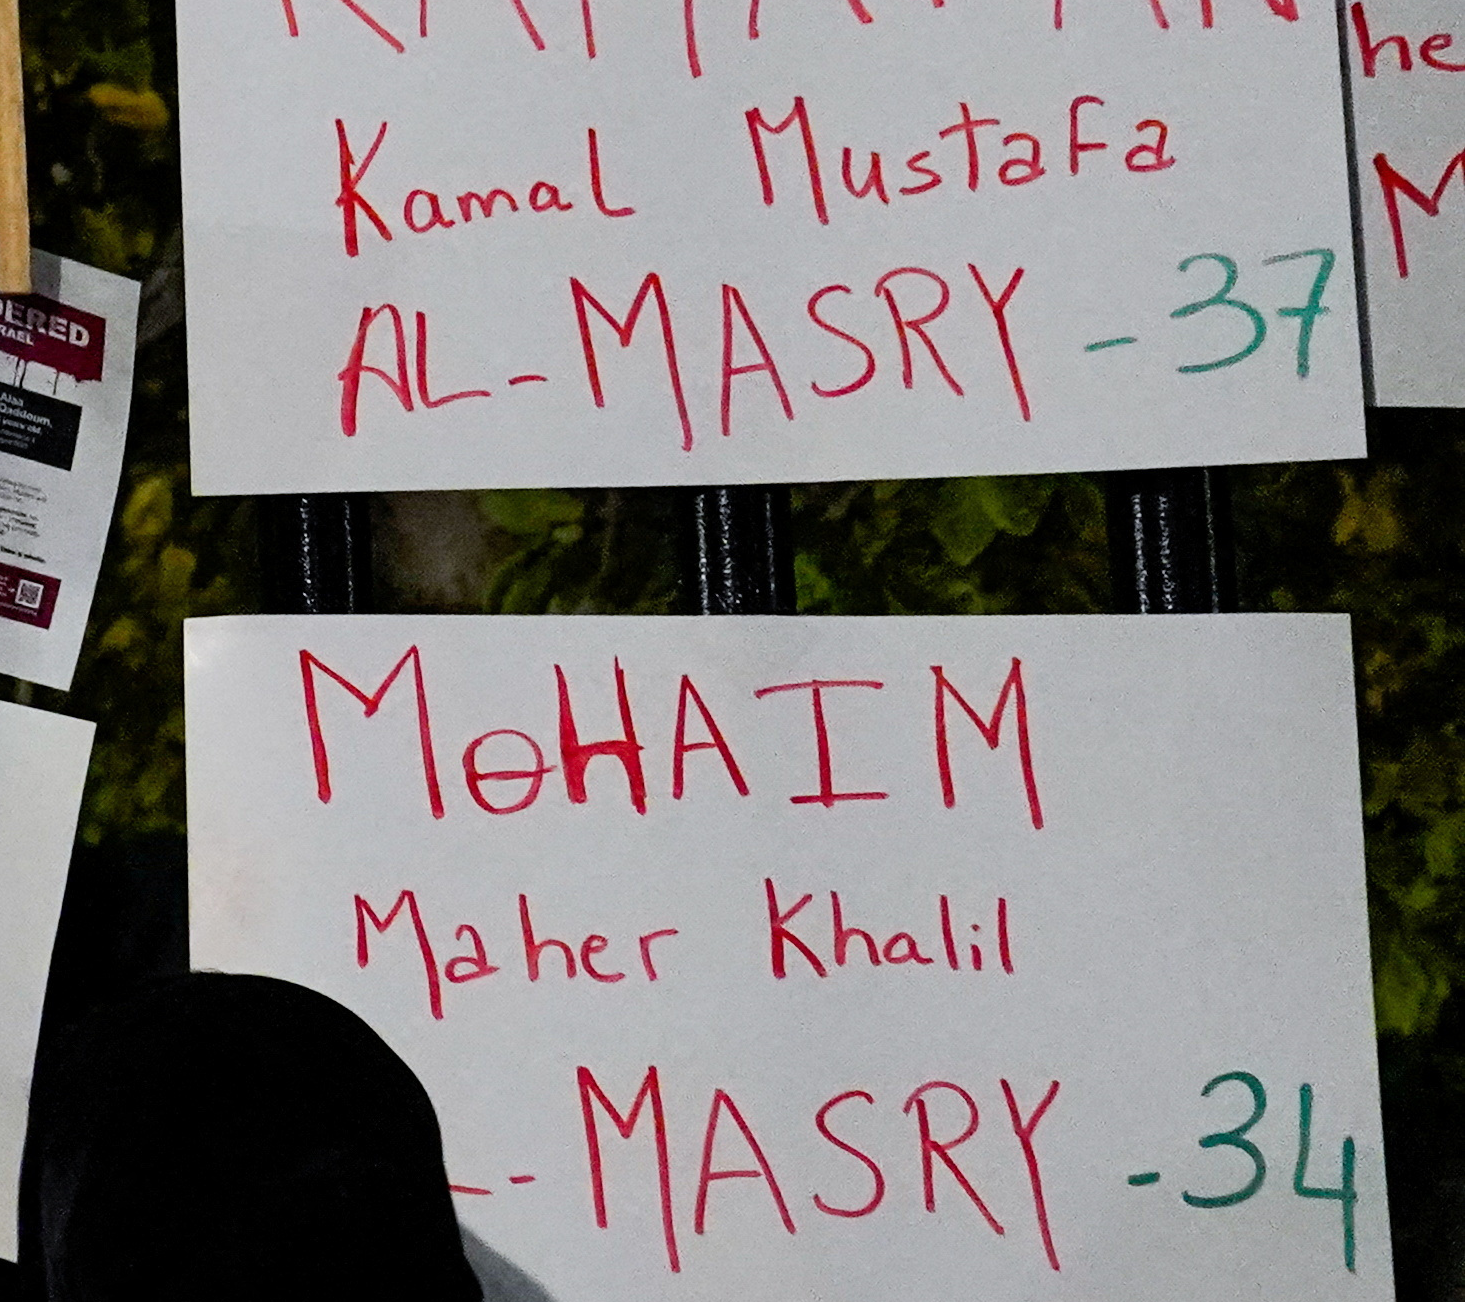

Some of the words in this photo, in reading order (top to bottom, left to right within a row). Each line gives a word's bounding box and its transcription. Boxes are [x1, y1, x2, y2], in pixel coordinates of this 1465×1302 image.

[334, 118, 637, 260] Kamal
[746, 95, 1176, 226] Mustafa
[338, 261, 1031, 453] AL-MASRY
[353, 889, 679, 1020] Maher
[764, 877, 1014, 981] Khalil
[449, 1063, 1060, 1274] -MASRY
